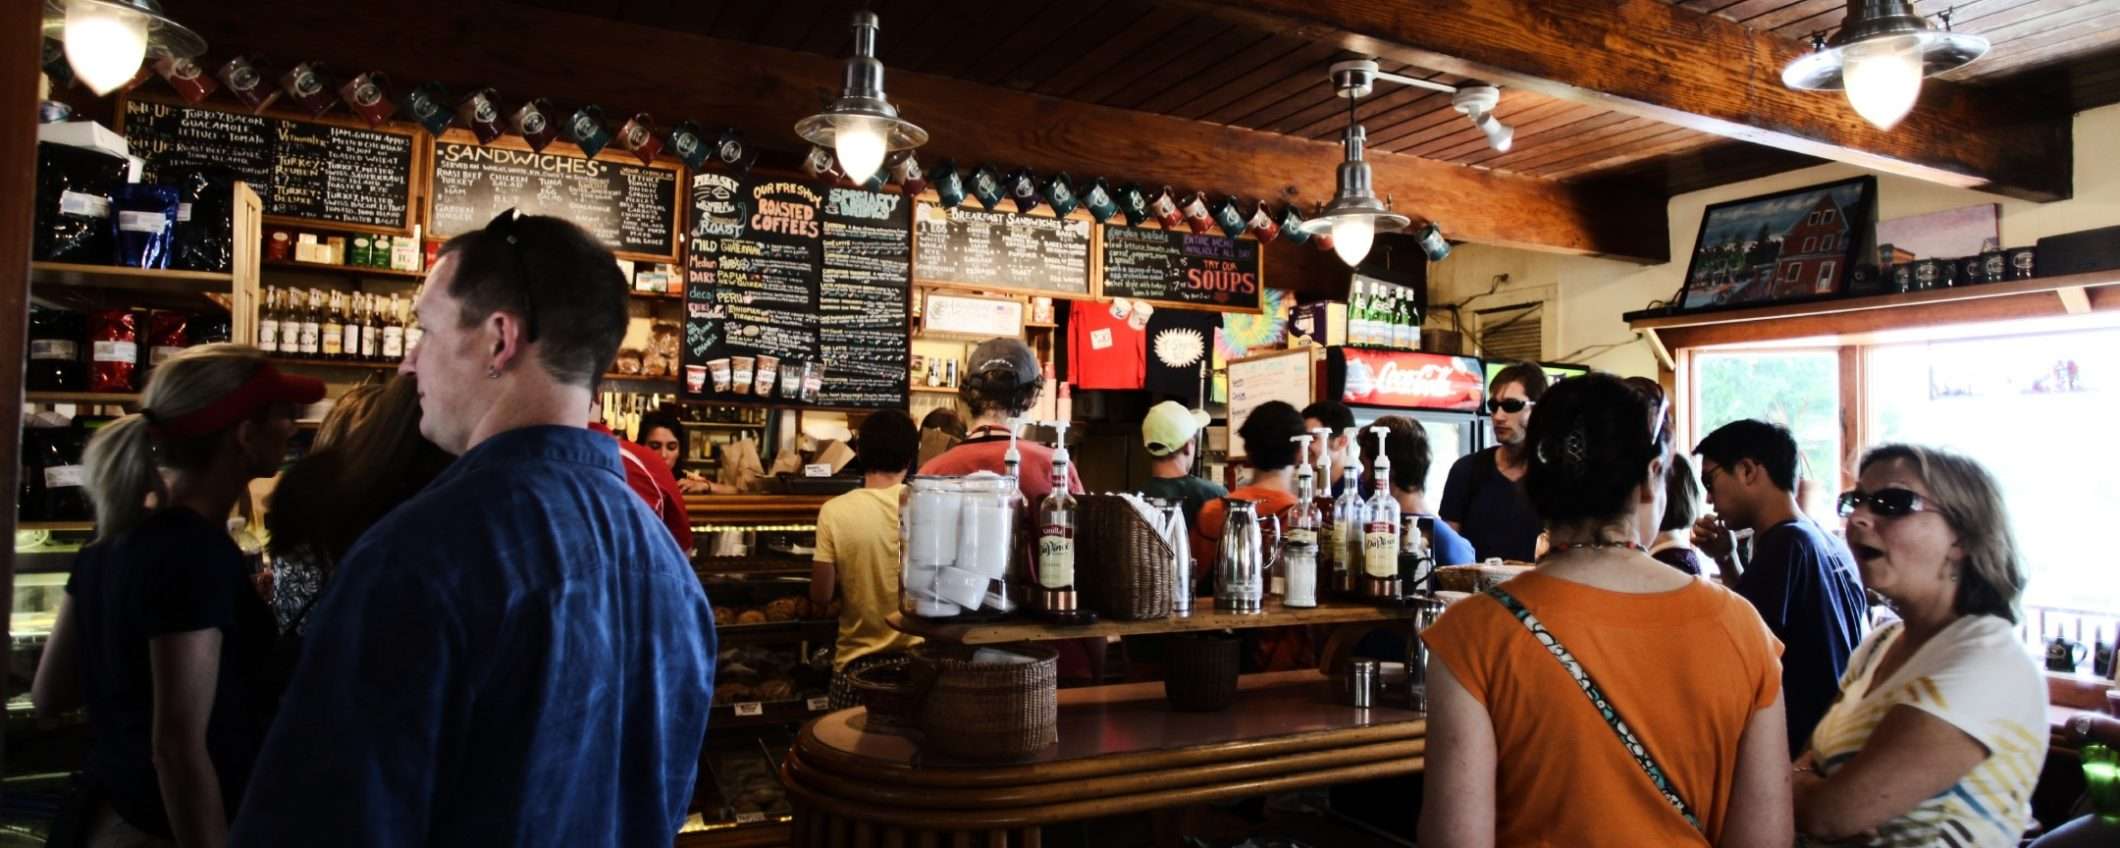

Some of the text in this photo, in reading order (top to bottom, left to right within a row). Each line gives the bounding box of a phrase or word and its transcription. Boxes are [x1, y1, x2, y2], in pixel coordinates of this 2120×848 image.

[444, 145, 600, 178] SANDWICHES
[441, 177, 474, 187] TURKEY
[463, 171, 482, 181] BEEF
[489, 172, 528, 183] CHICKEN
[539, 177, 563, 187] TUNA
[753, 182, 774, 199] OUR
[775, 182, 823, 209] FRESHLY
[758, 198, 814, 222] ROASTED
[951, 207, 1062, 230] BREAKFAST SANDWICHES
[700, 219, 744, 239] ROAST
[752, 214, 820, 238] COFFEES
[692, 238, 718, 253] MILD
[1203, 259, 1220, 270] TRY
[717, 270, 748, 281] PAPUA
[1187, 268, 1256, 295] SOUPS
[716, 291, 743, 304] PERU
[822, 358, 840, 367] TEA
